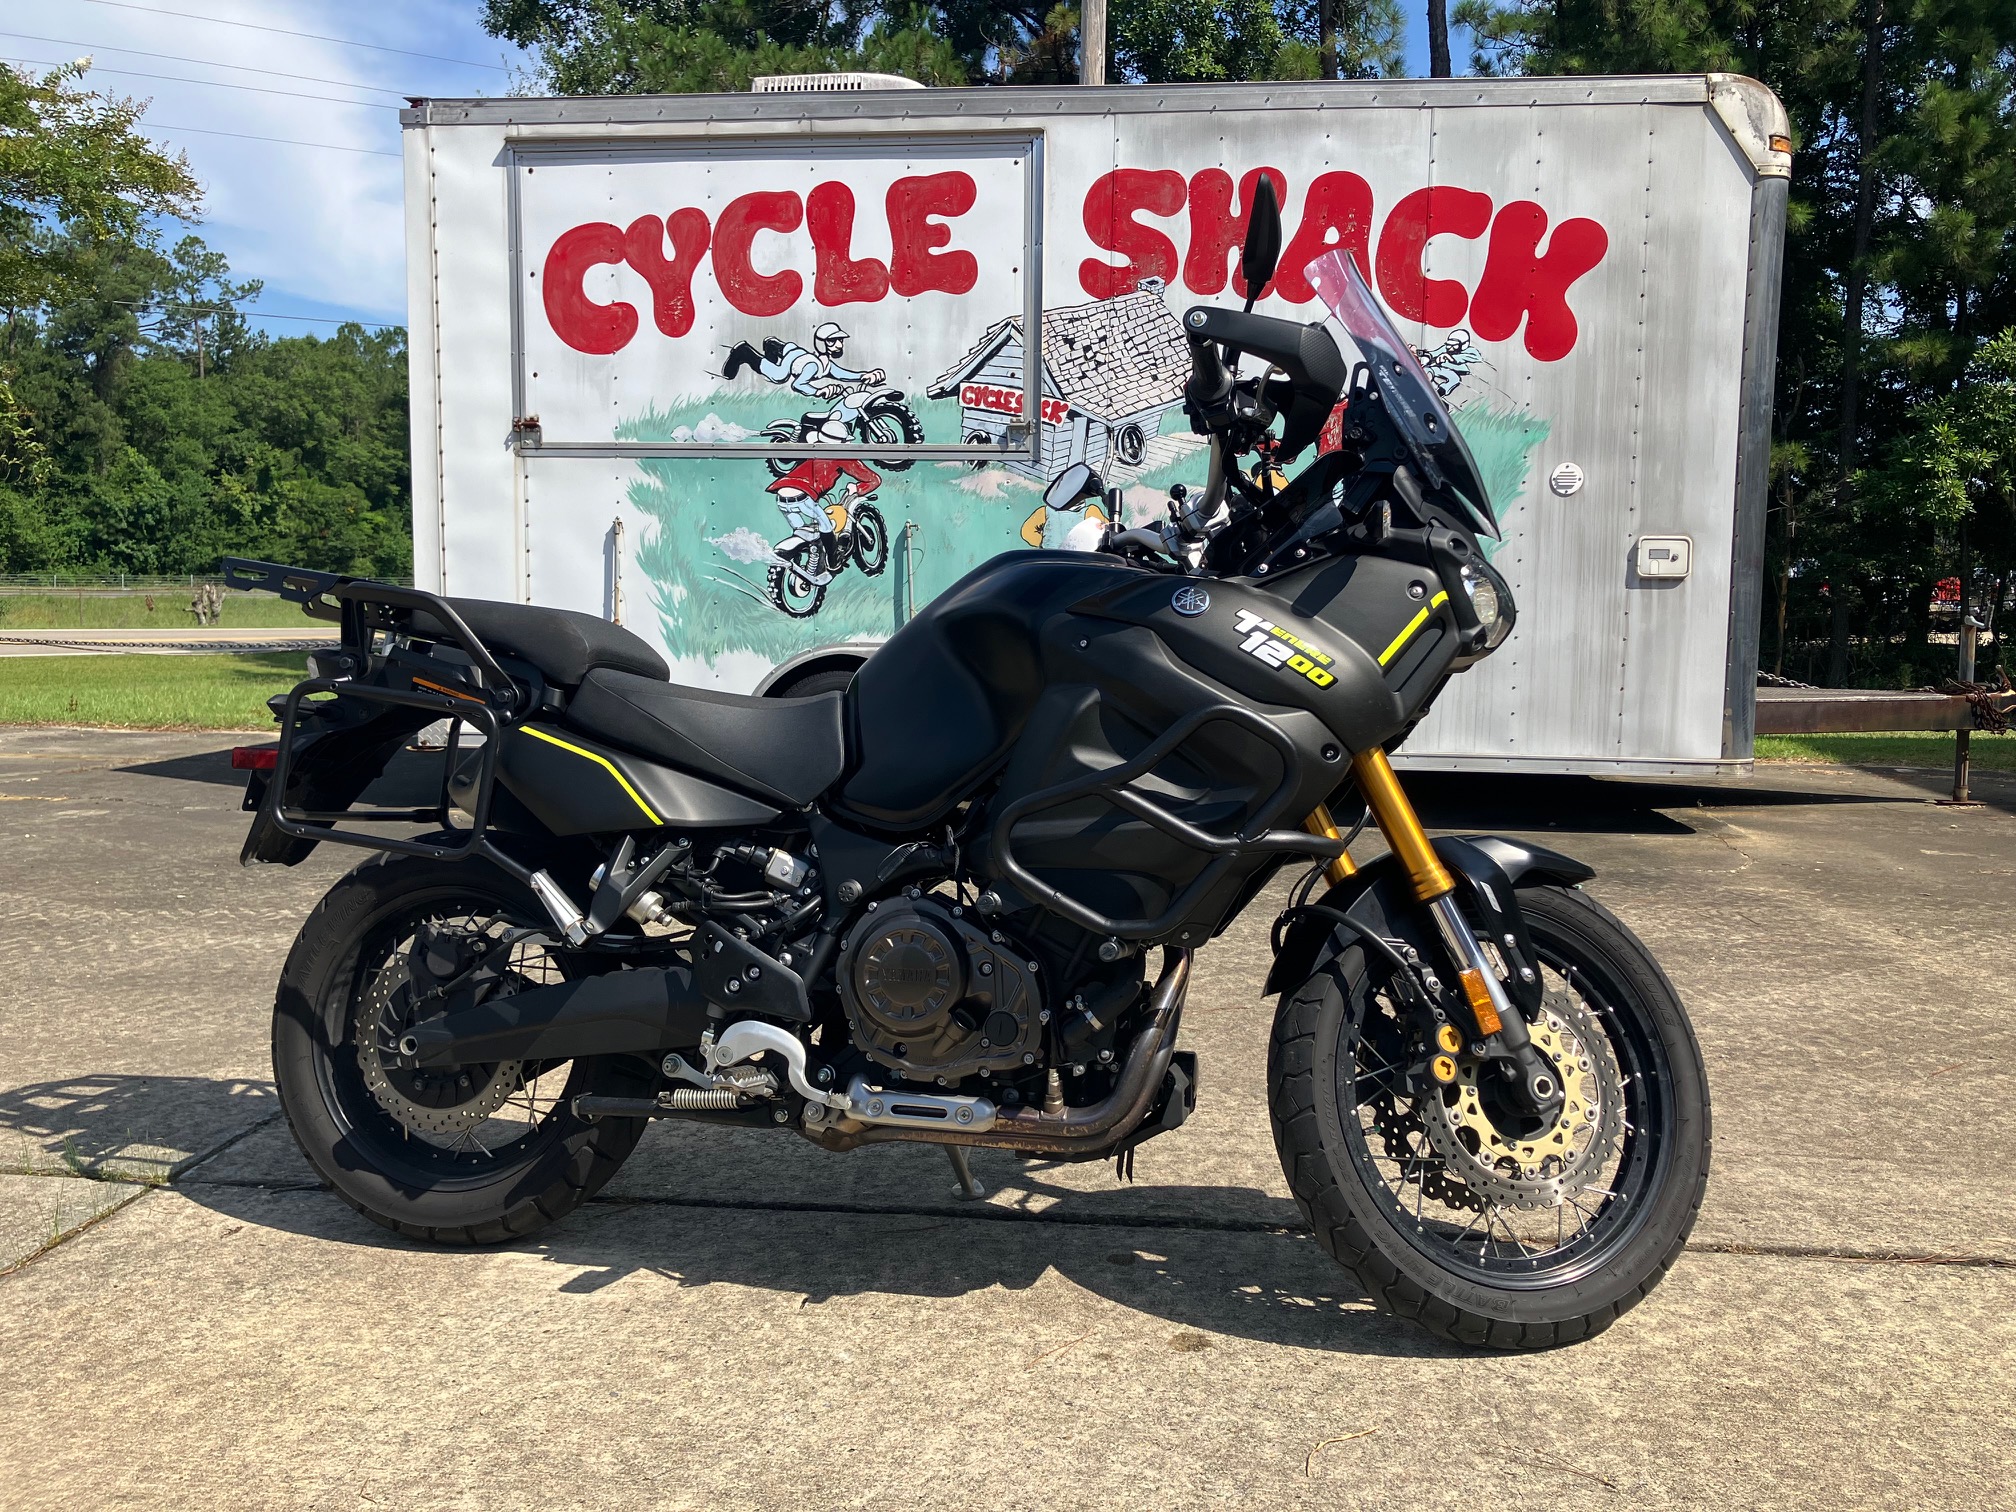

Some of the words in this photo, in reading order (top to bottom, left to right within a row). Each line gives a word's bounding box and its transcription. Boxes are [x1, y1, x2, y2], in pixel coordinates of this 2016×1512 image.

[543, 171, 978, 354] CYCLE
[1079, 167, 1608, 361] SHACK
[1238, 630, 1335, 687] 1200
[1373, 1229, 1426, 1278] WING
[1425, 1272, 1512, 1314] BATTLE
